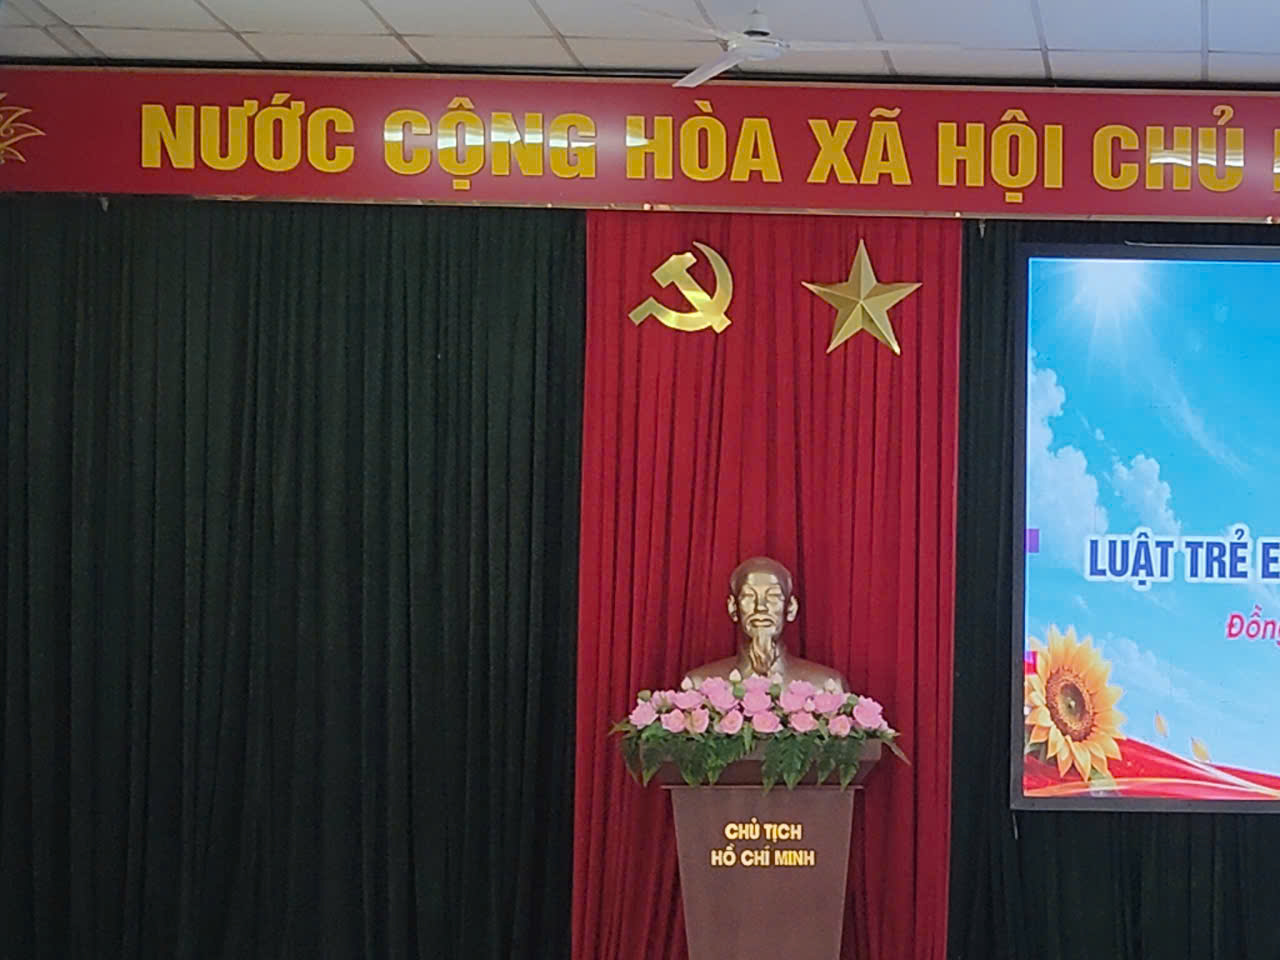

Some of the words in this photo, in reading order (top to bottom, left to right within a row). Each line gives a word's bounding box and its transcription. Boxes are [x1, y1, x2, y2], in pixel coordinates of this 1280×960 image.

[141, 93, 355, 173] NƯỚC
[383, 97, 597, 190] CỘNG
[625, 101, 783, 183] HÒA
[807, 108, 912, 186] XÃ
[938, 110, 1064, 203] HỘI
[1092, 105, 1245, 193] CHỦ
[1088, 531, 1174, 586] LUẬT
[1185, 528, 1249, 579] TRẺ
[724, 817, 760, 840] CHỦ
[763, 823, 802, 843] TỊCH
[711, 843, 736, 866] HỒ
[740, 844, 770, 866] CHÍ
[774, 849, 815, 866] MINH
